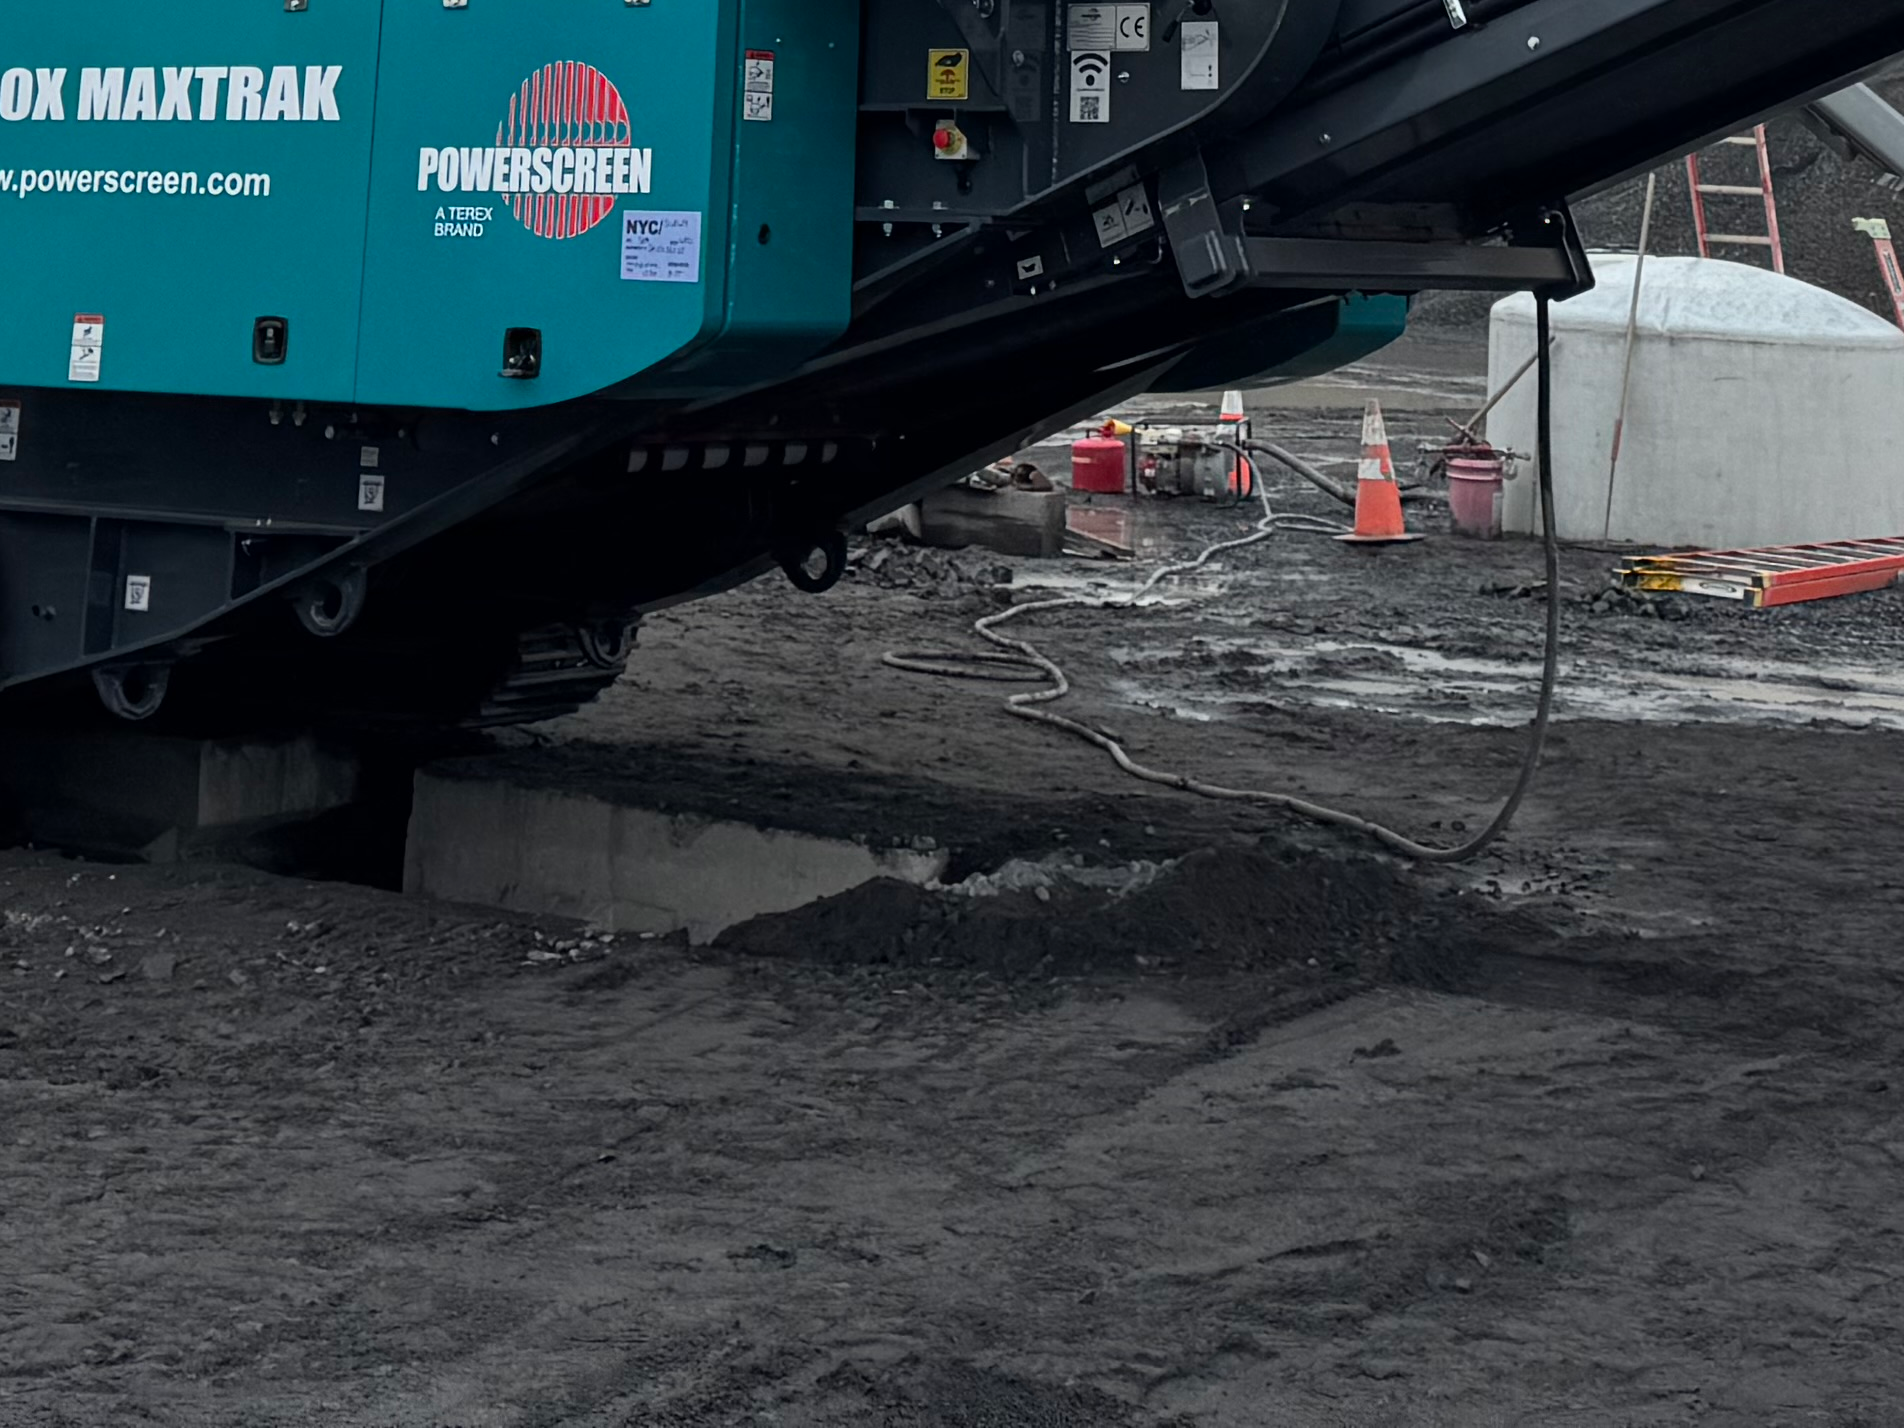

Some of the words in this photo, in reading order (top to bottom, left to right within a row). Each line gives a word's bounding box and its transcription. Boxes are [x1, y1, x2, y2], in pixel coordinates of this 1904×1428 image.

[77, 65, 343, 121] MAXTRAK
[417, 147, 652, 193] POWERSCREEN
[435, 207, 445, 220] A
[448, 206, 493, 221] TEREX
[434, 222, 484, 237] BRAND
